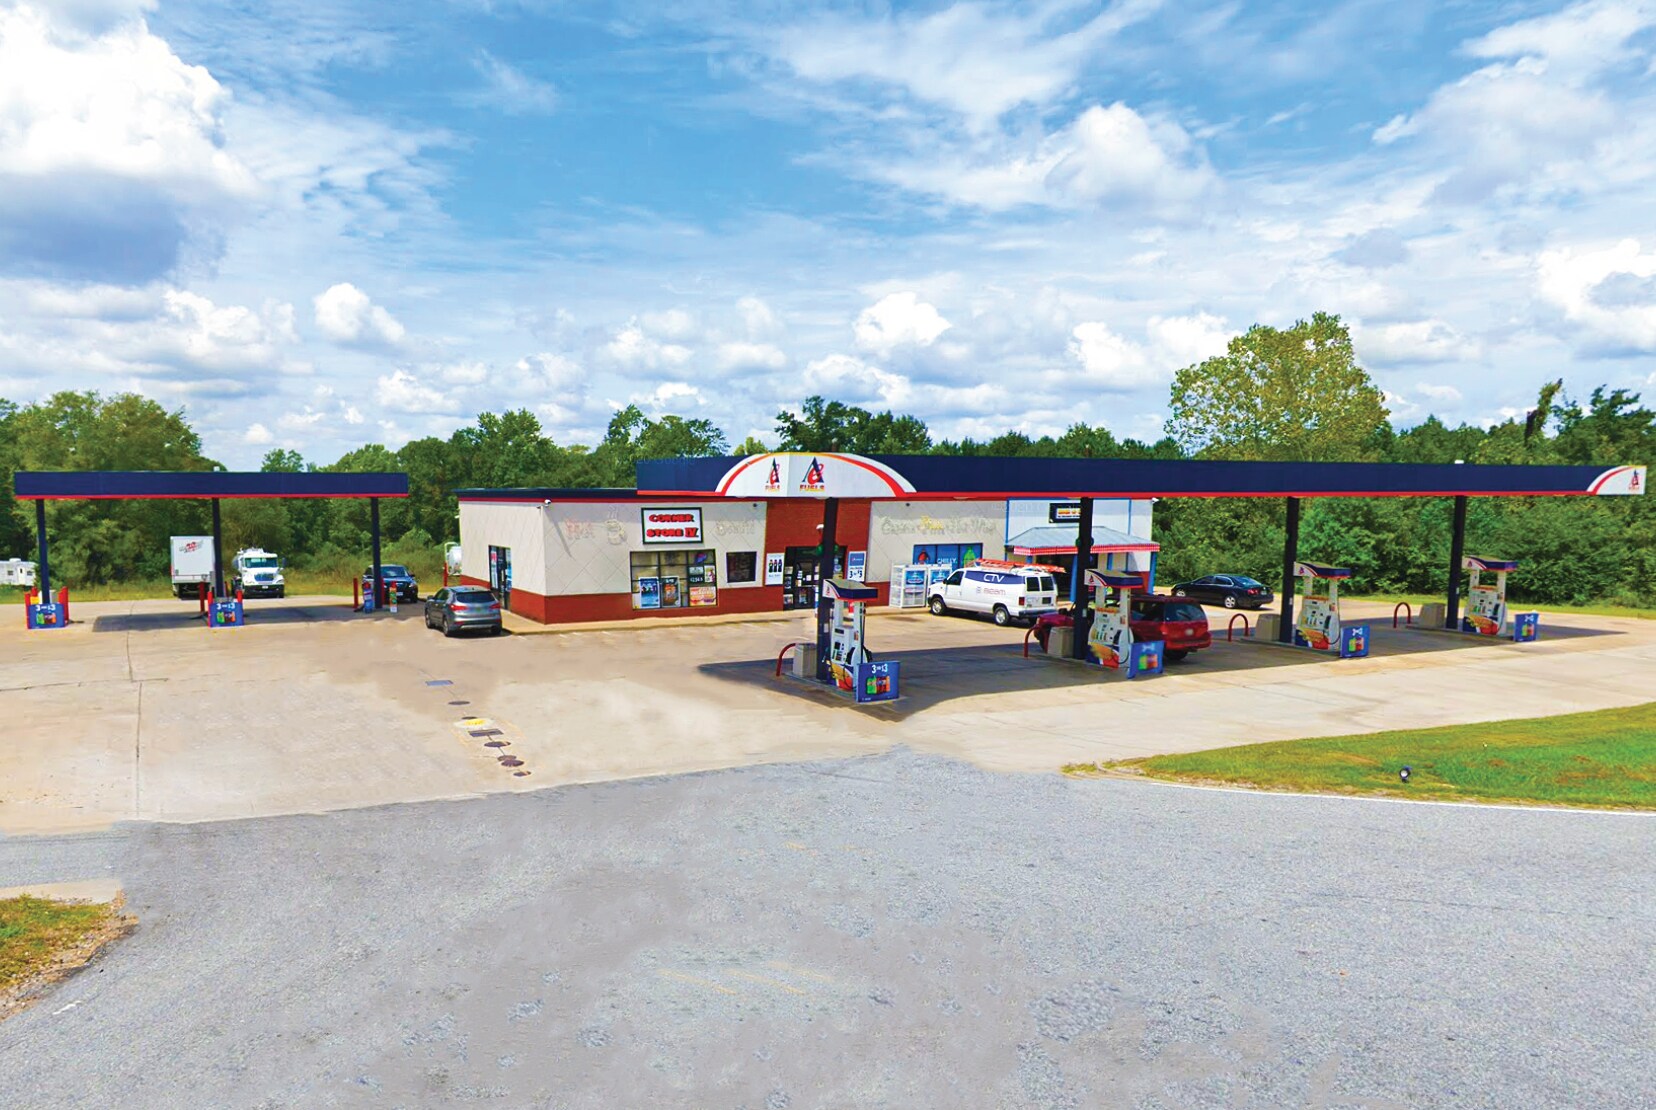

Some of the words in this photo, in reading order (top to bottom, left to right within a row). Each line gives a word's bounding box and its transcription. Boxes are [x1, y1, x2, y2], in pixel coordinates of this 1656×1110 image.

[649, 514, 694, 522] CORNER
[646, 529, 684, 537] STORE
[685, 527, 699, 537] IV
[983, 573, 1005, 583] CTV
[871, 664, 877, 674] 3
